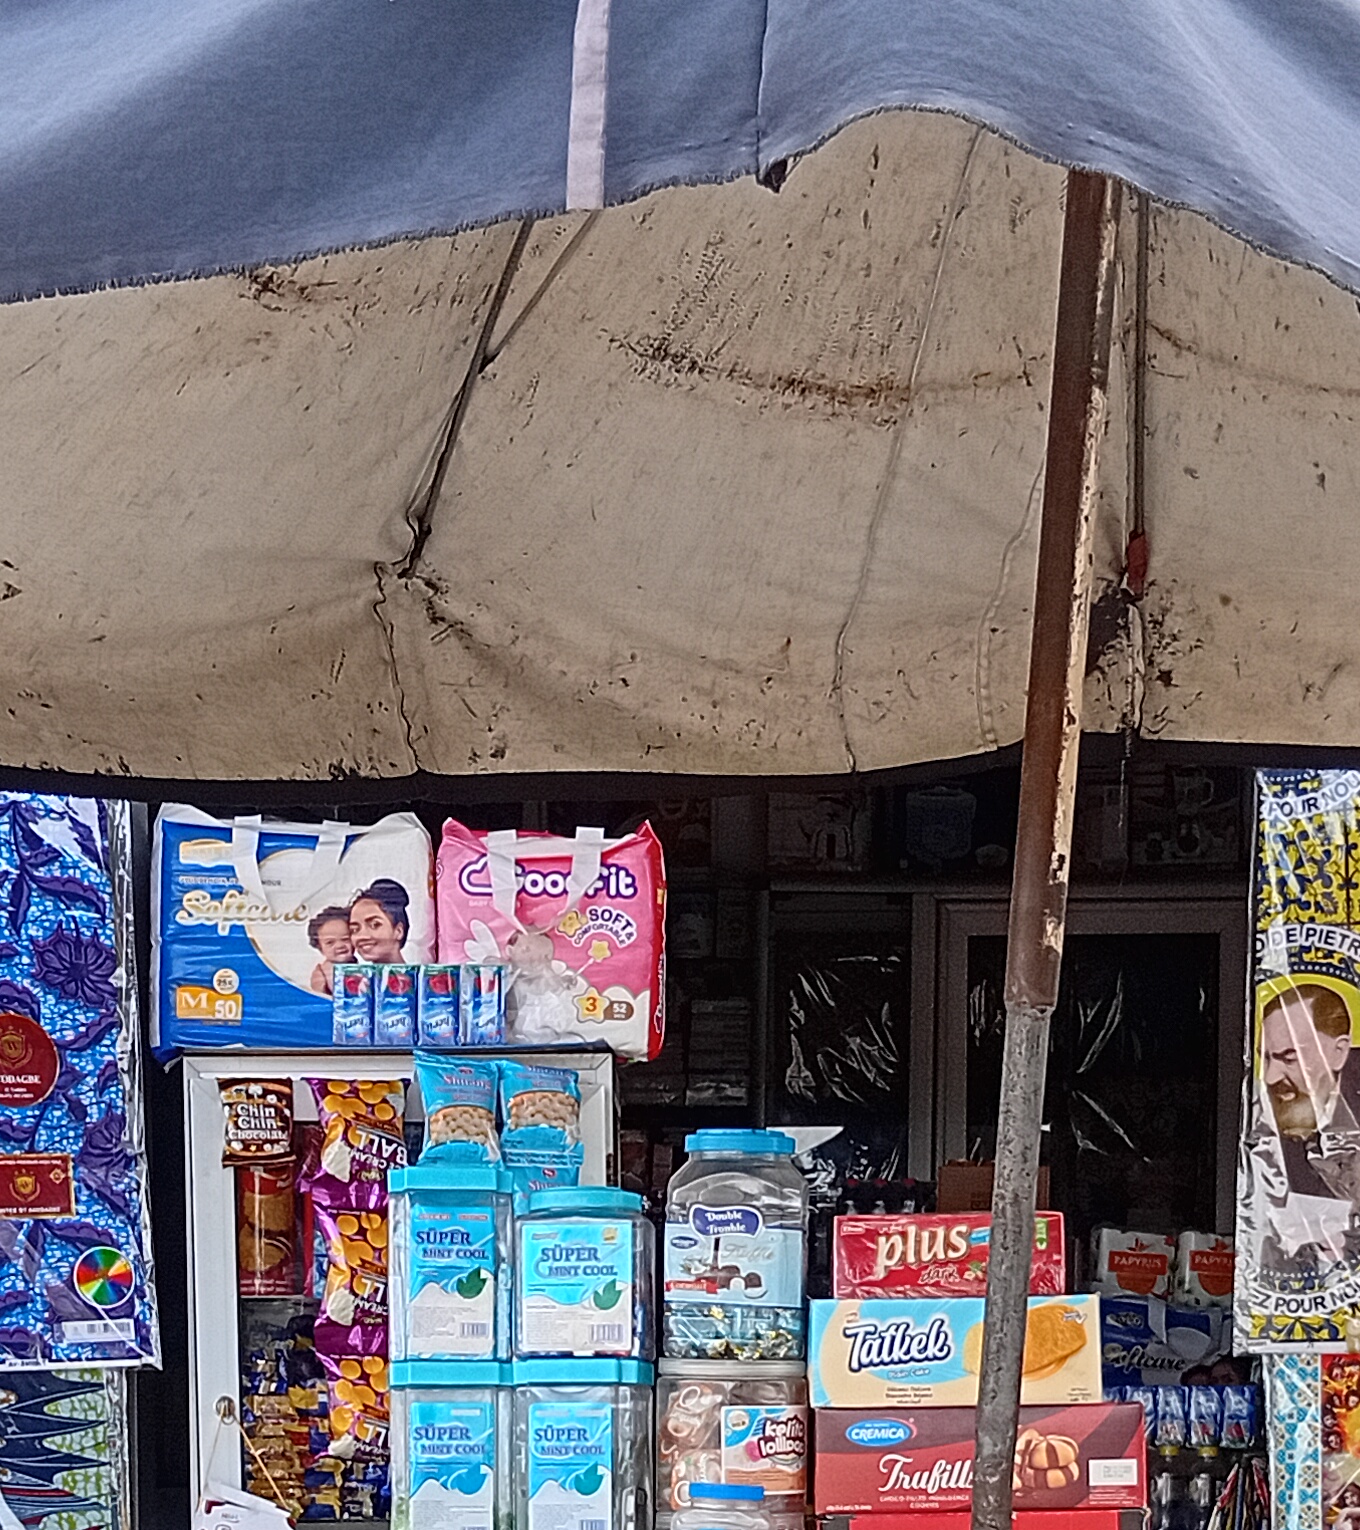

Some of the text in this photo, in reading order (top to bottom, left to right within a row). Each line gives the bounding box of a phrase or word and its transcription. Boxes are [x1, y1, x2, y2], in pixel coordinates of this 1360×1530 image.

[588, 907, 633, 932] SOFT
[573, 923, 627, 946] COMFORTABLE
[1268, 924, 1299, 946] DE
[180, 991, 237, 1018] M 50
[584, 996, 627, 1014] 3 52
[236, 1104, 276, 1118] Chin
[237, 1116, 277, 1129] Chin
[704, 1210, 743, 1221] Double
[416, 1228, 471, 1245] SÜPER
[455, 1249, 489, 1260] COOL
[541, 1244, 600, 1262] SÜPER
[875, 1223, 970, 1279] plus
[582, 1264, 618, 1276] COOL
[1114, 1254, 1162, 1268] PAPYRUS
[1273, 1296, 1326, 1316] POUR
[843, 1318, 953, 1373] Tatkek
[851, 1428, 905, 1441] CREMICA
[878, 1453, 974, 1494] Trufill
